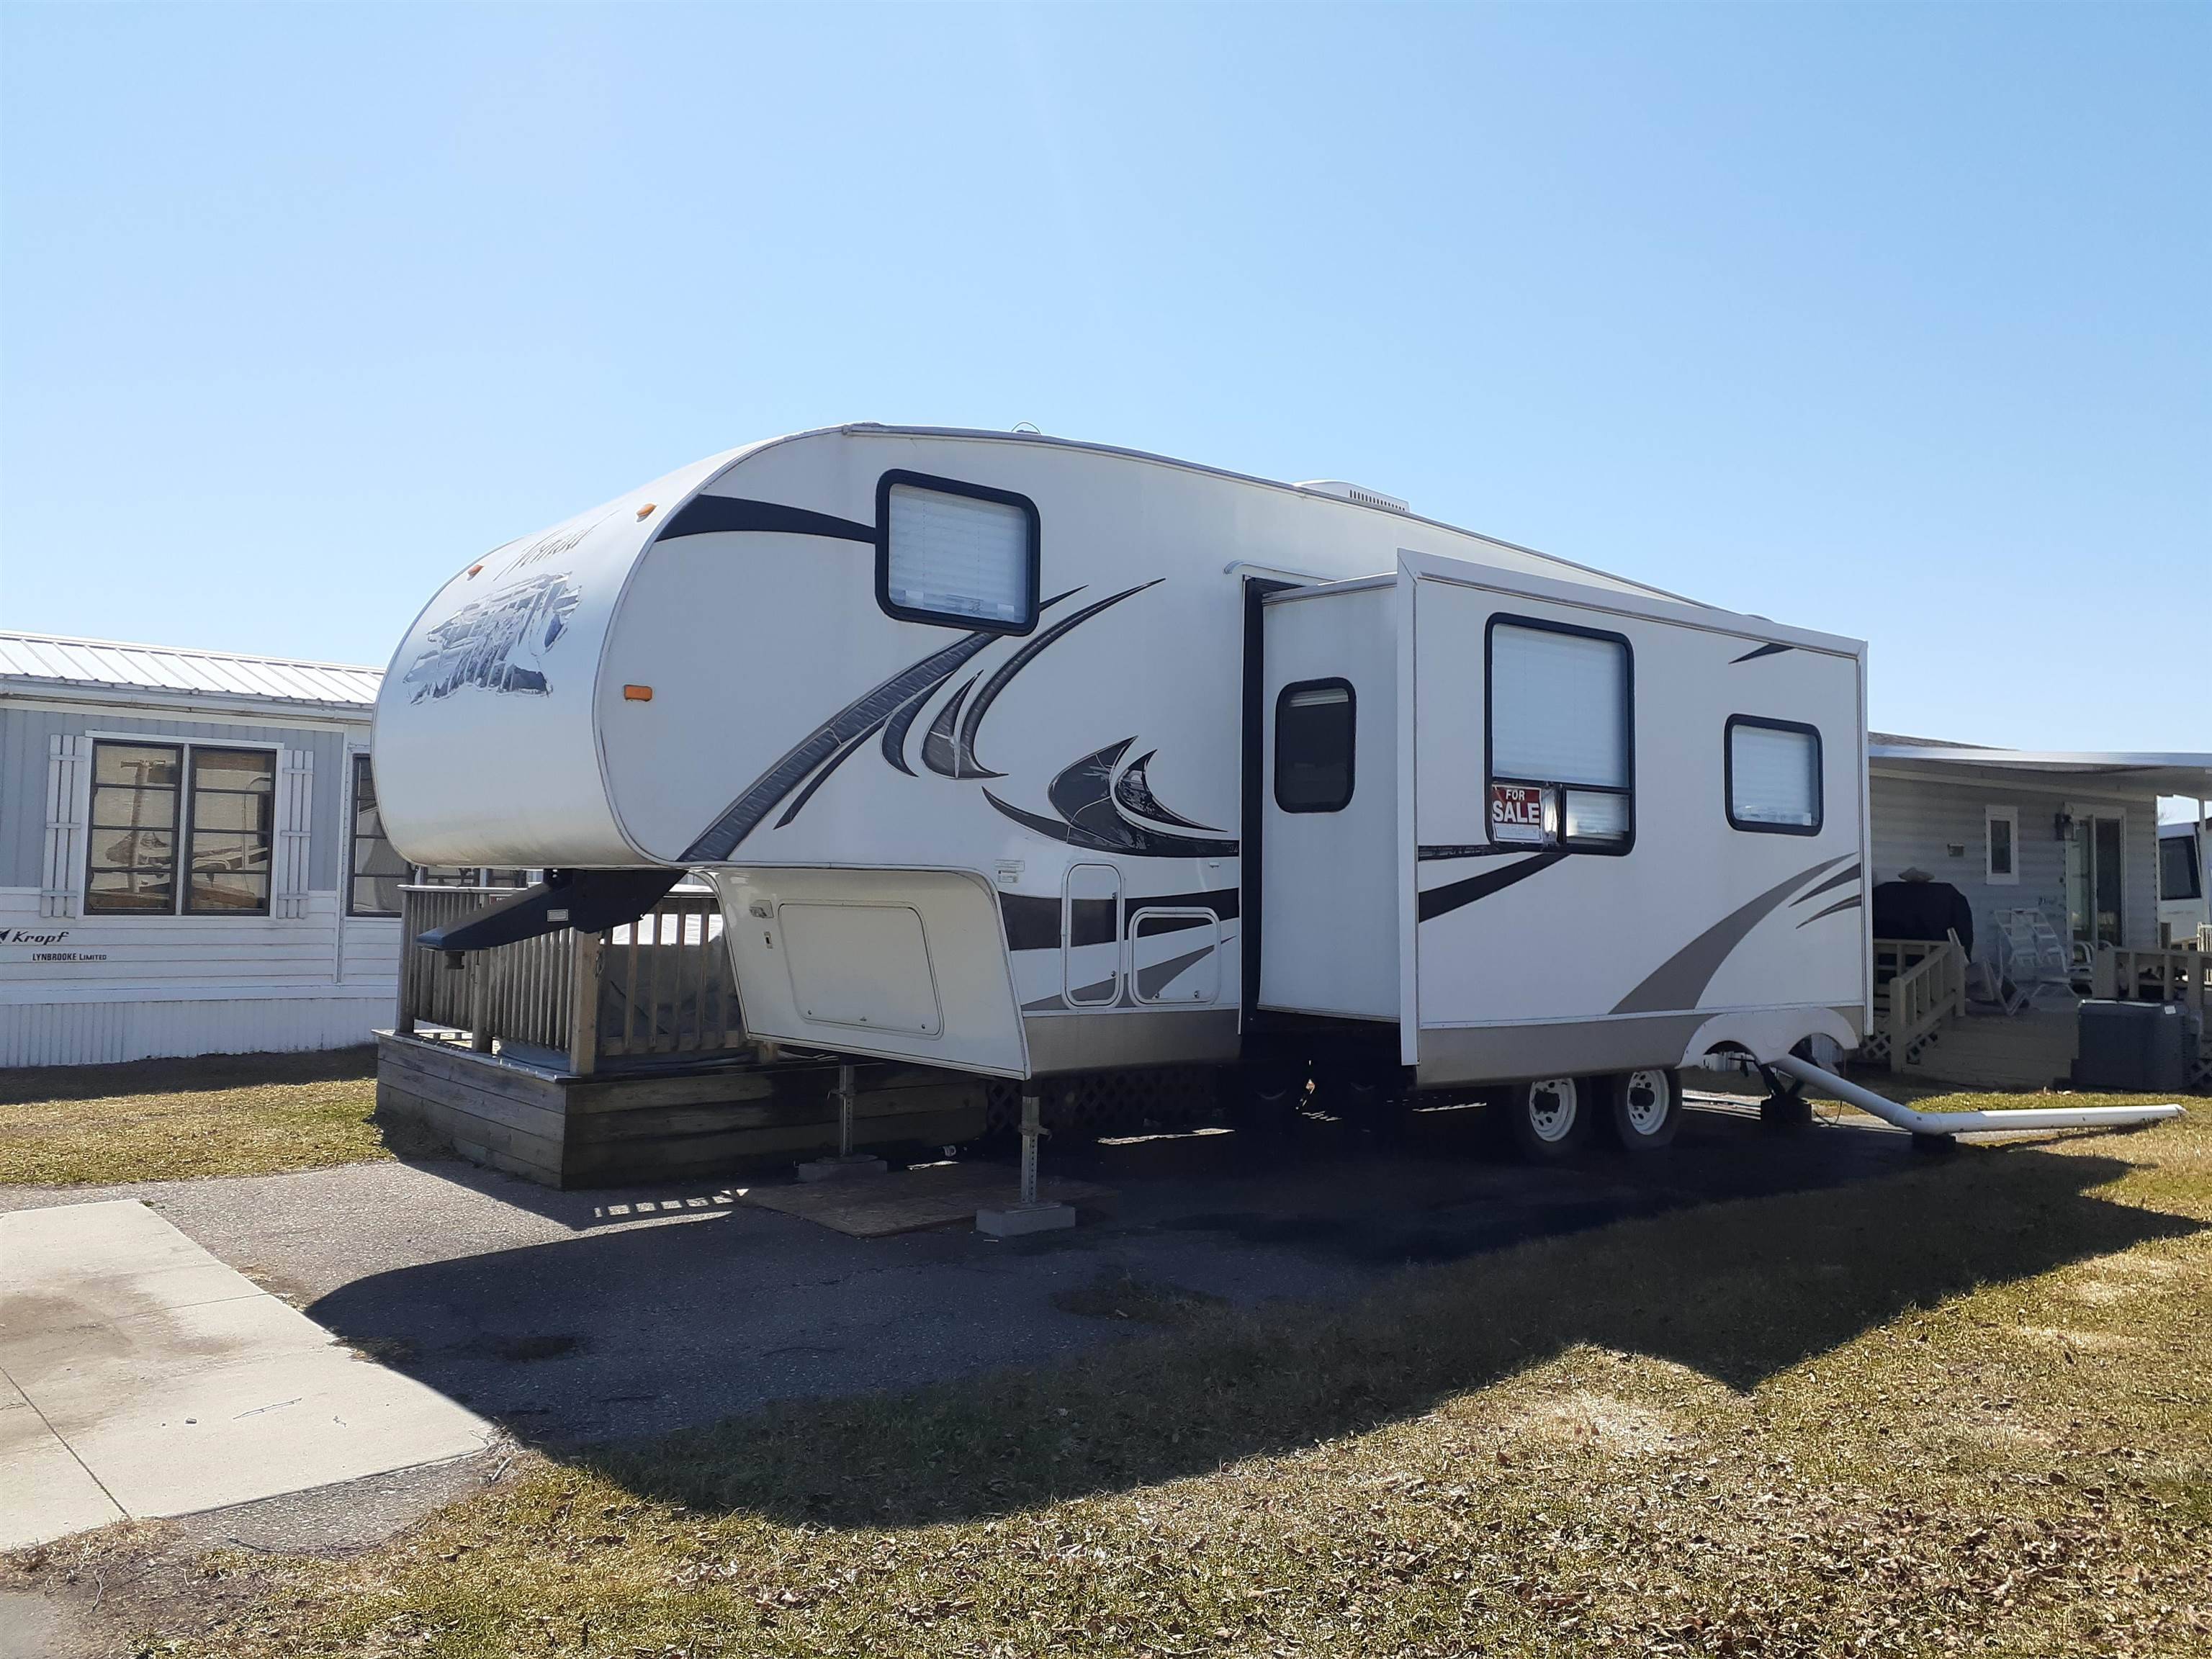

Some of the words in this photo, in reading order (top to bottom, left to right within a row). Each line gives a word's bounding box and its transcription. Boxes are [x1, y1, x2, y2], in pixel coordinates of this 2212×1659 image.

[1506, 789, 1525, 801] FOR
[1493, 801, 1539, 823] SALE
[12, 931, 69, 945] Kropf
